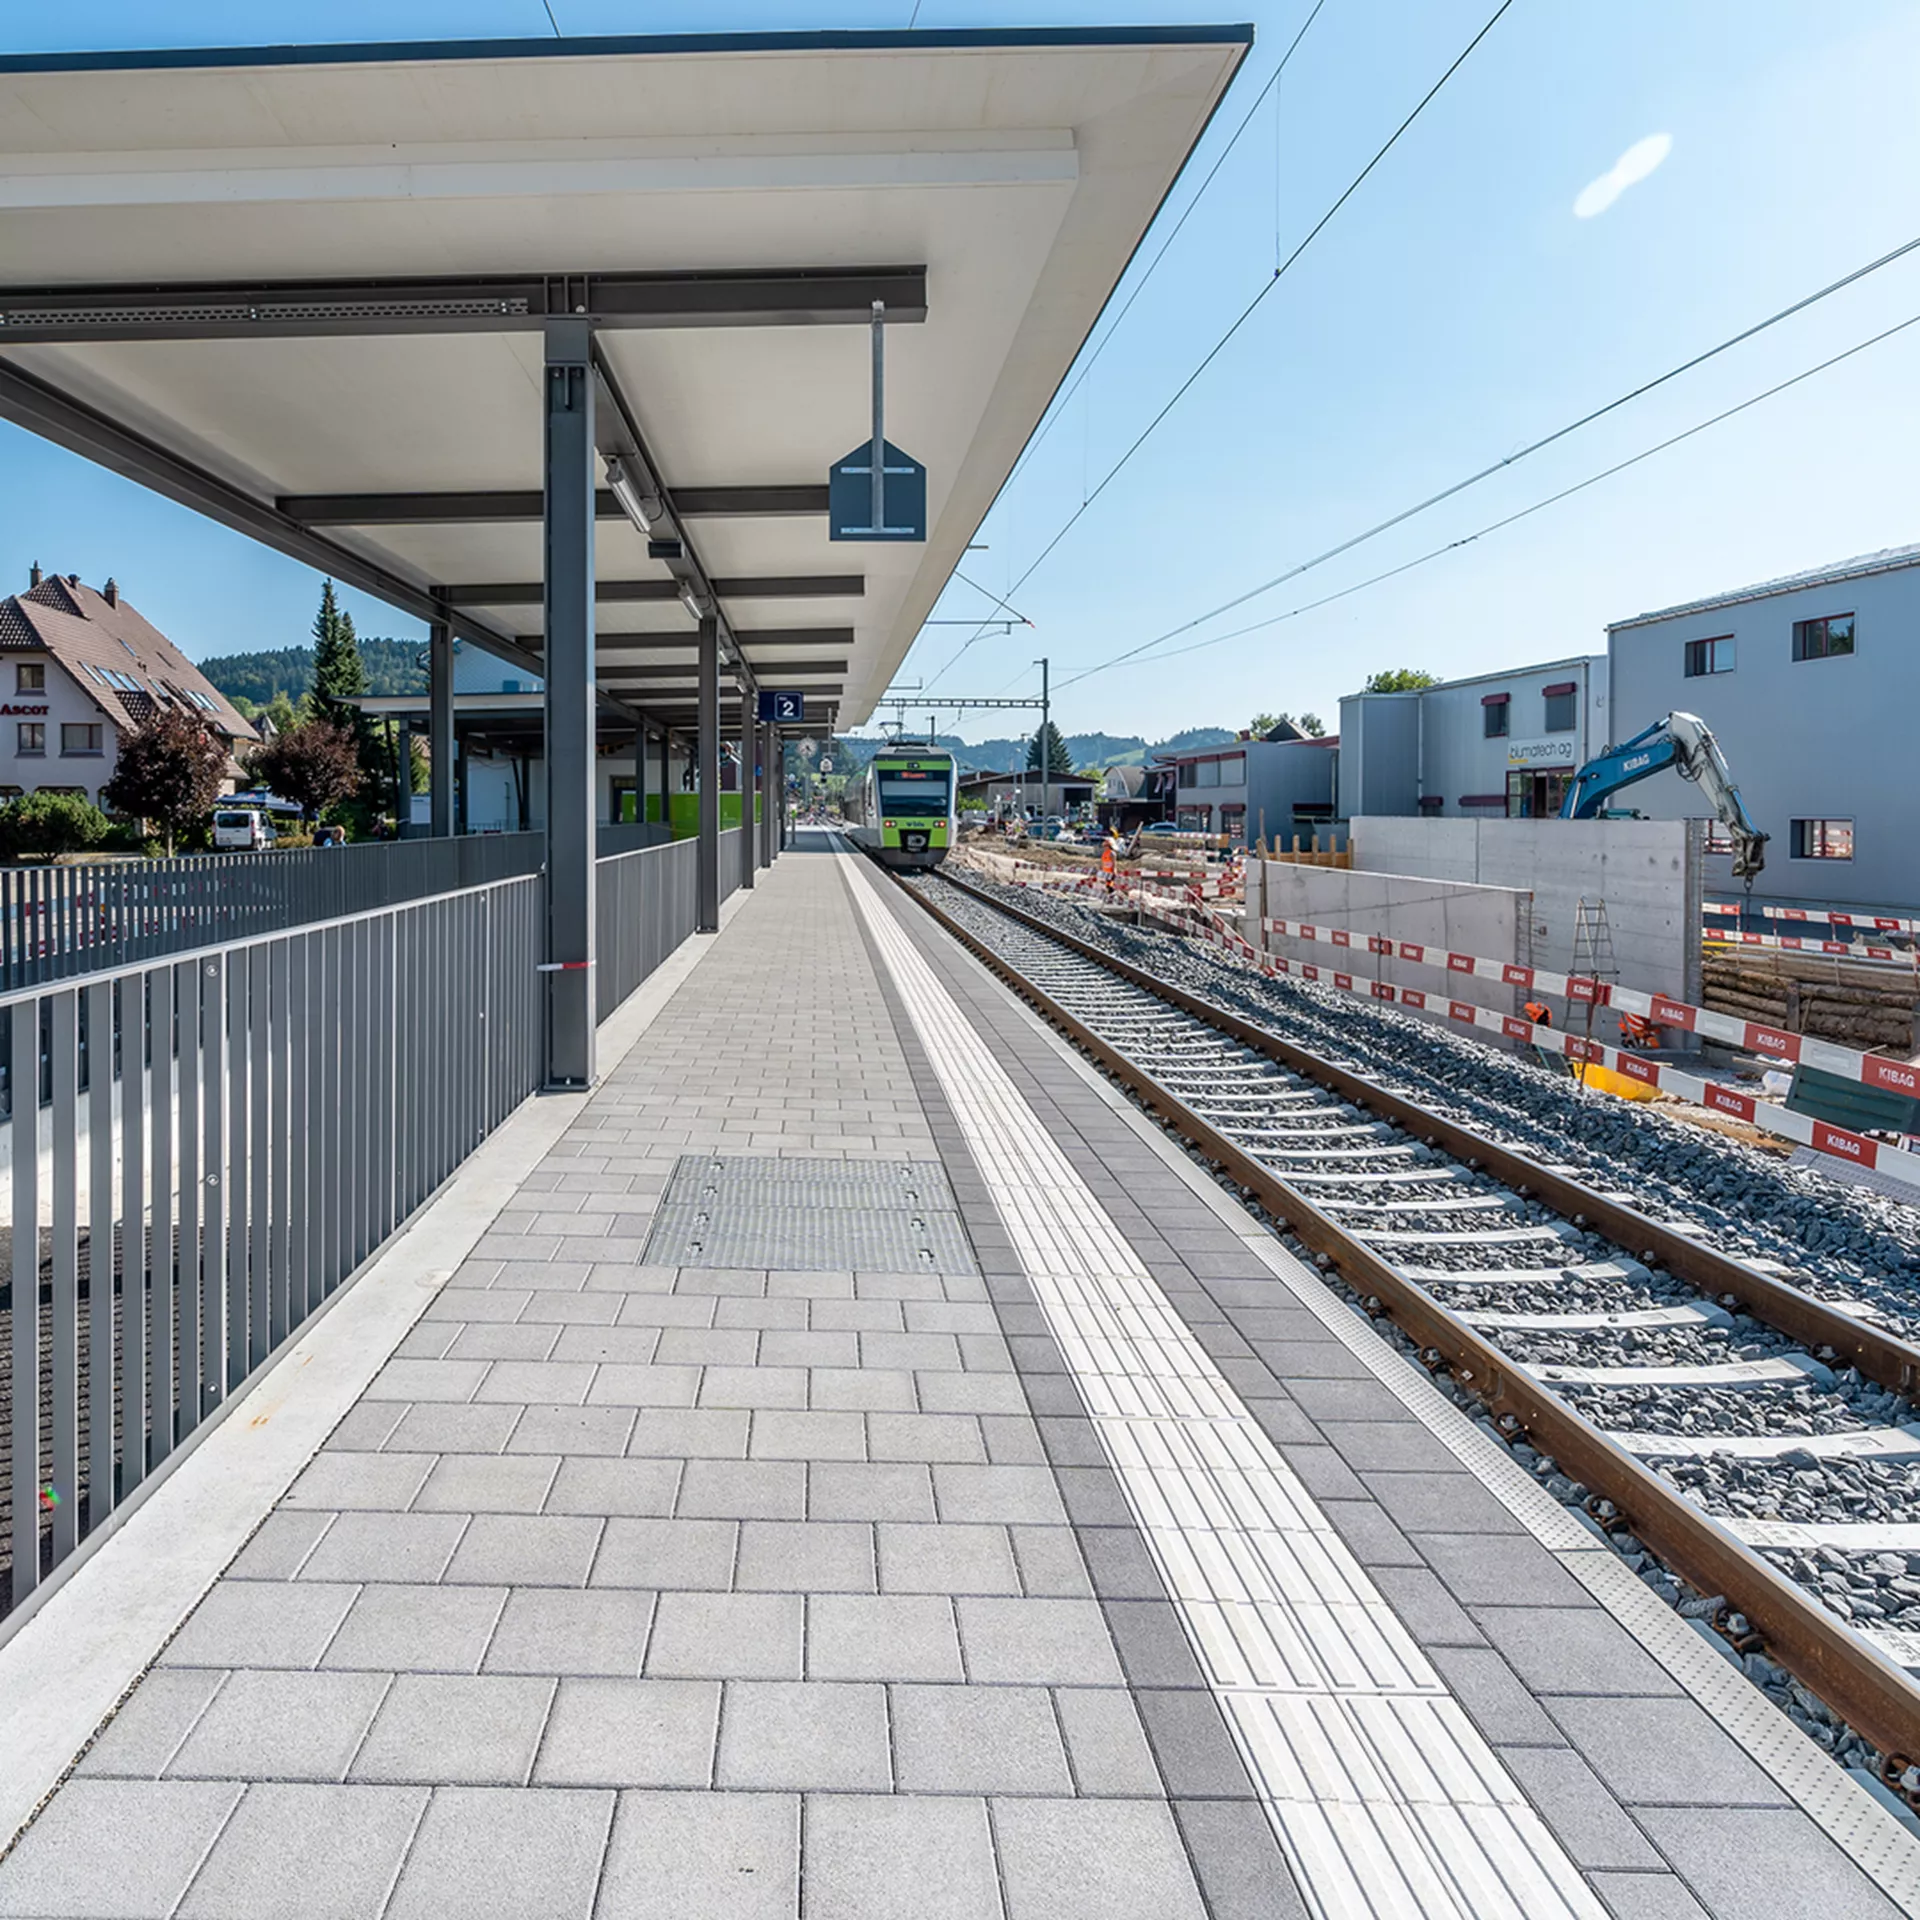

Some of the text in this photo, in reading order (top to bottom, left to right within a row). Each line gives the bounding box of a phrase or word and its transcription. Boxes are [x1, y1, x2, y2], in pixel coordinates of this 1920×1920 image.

[783, 701, 794, 716] 2
[1510, 742, 1573, 760] blumatech ag
[1623, 753, 1650, 772] KIBAG
[1660, 1007, 1685, 1022] KIBAG
[1756, 1033, 1786, 1051] KIBAG
[1626, 1061, 1649, 1078] KIBAG
[1878, 1067, 1915, 1088] KIBAG
[1715, 1094, 1743, 1112] KIBAG
[1827, 1134, 1861, 1156] KIBAG
